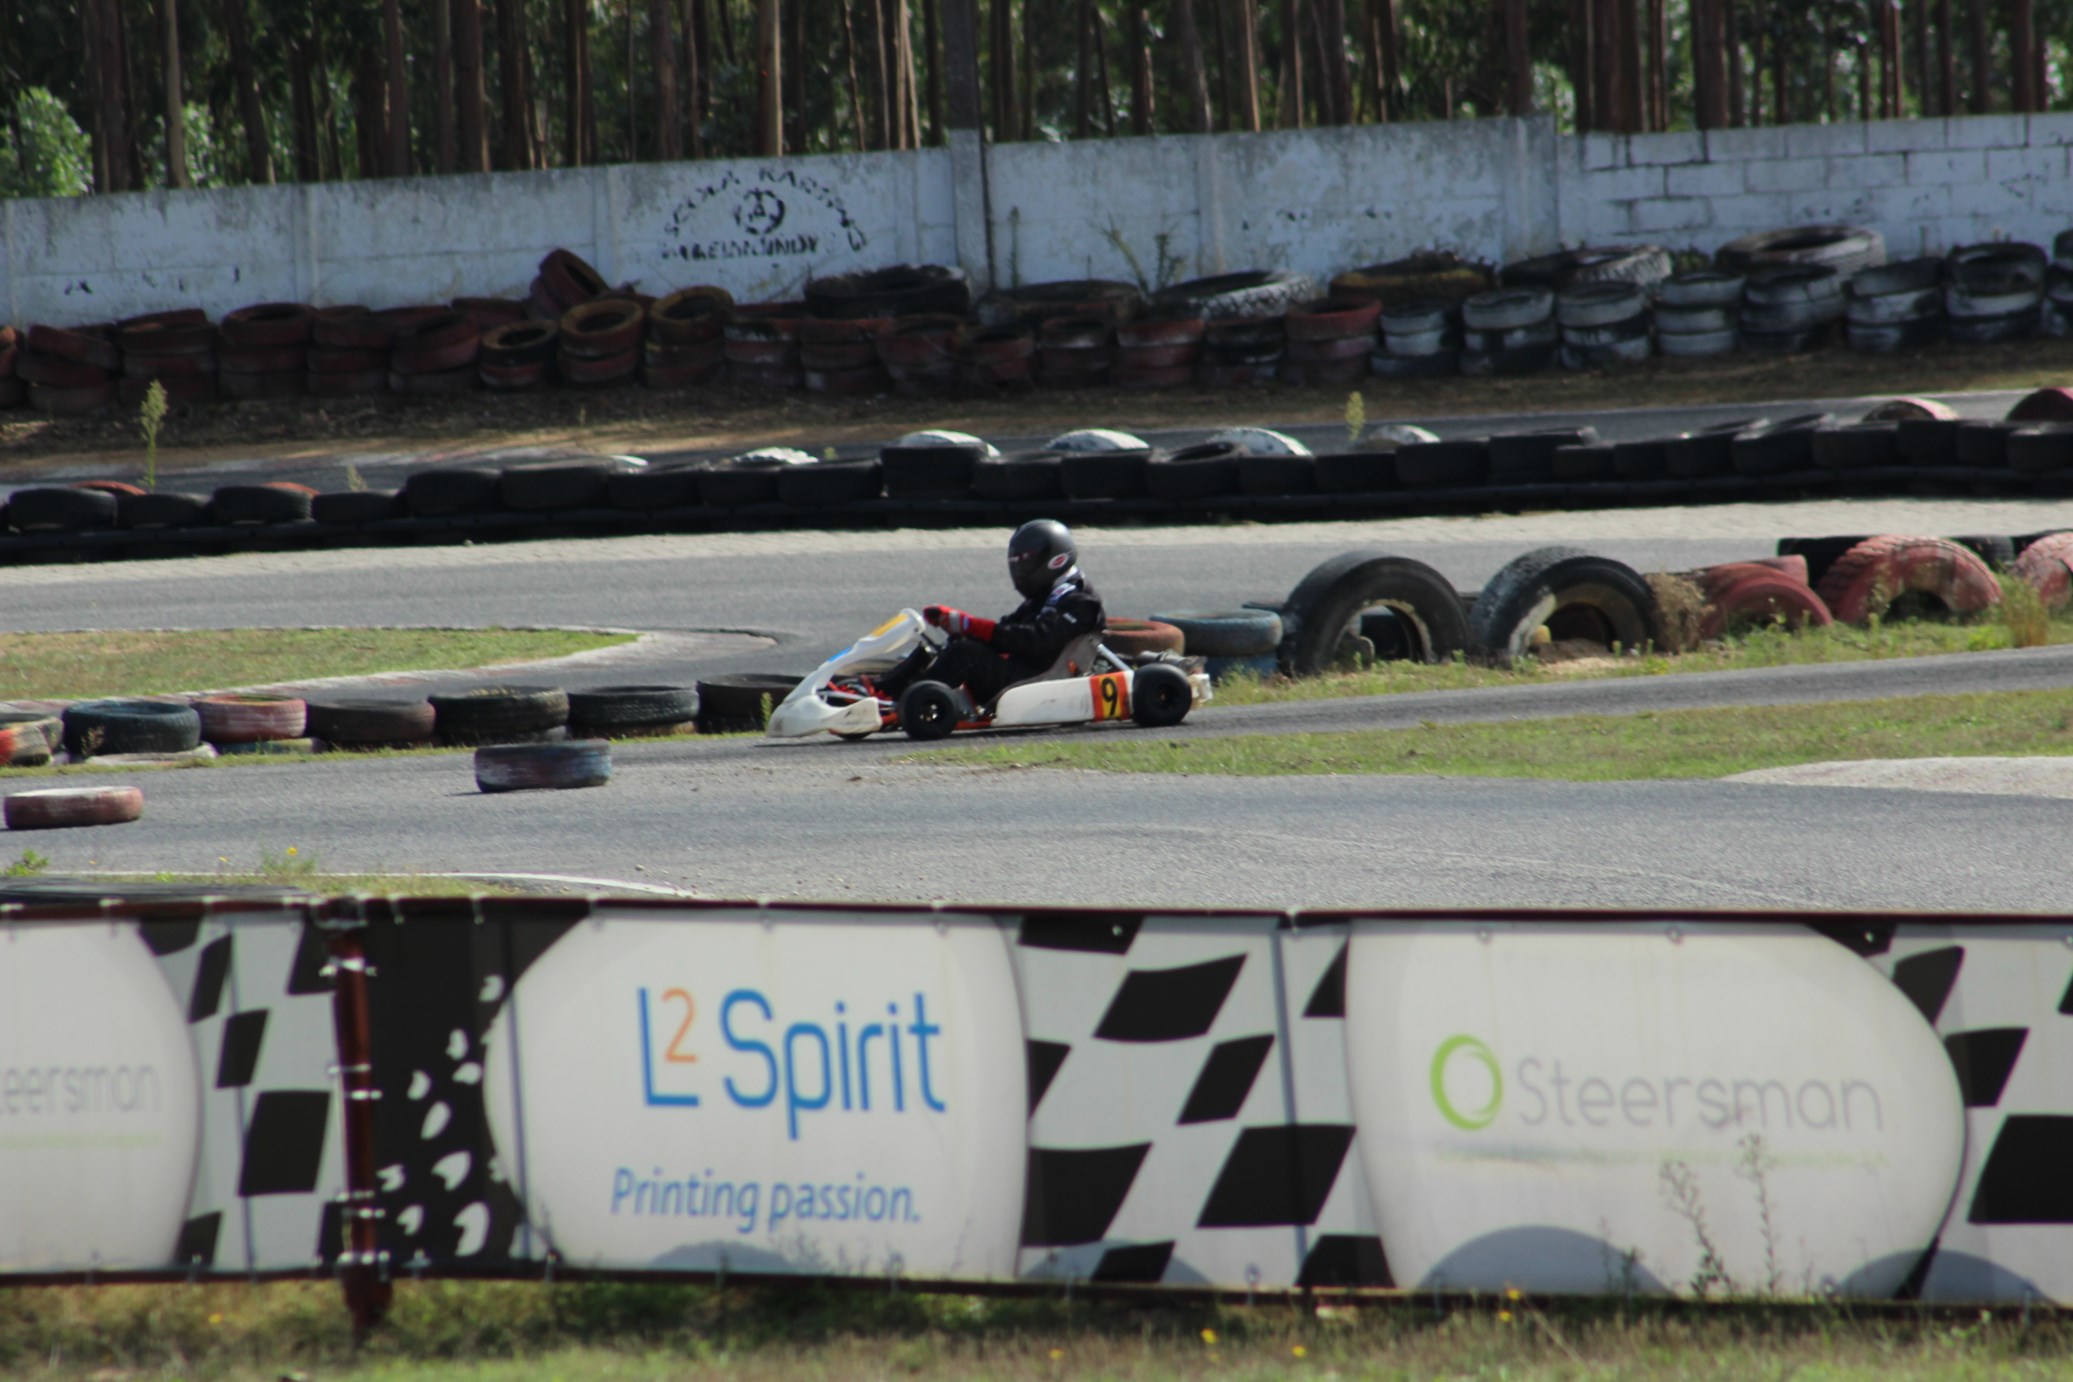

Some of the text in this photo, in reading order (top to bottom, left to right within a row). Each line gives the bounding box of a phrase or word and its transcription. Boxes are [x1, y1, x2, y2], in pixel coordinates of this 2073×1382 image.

[1101, 677, 1118, 717] 9
[0, 1064, 161, 1115] eersman
[718, 988, 947, 1141] Spirit
[1515, 1055, 1884, 1132] Steersman
[610, 1166, 920, 1234] Printing passion.
